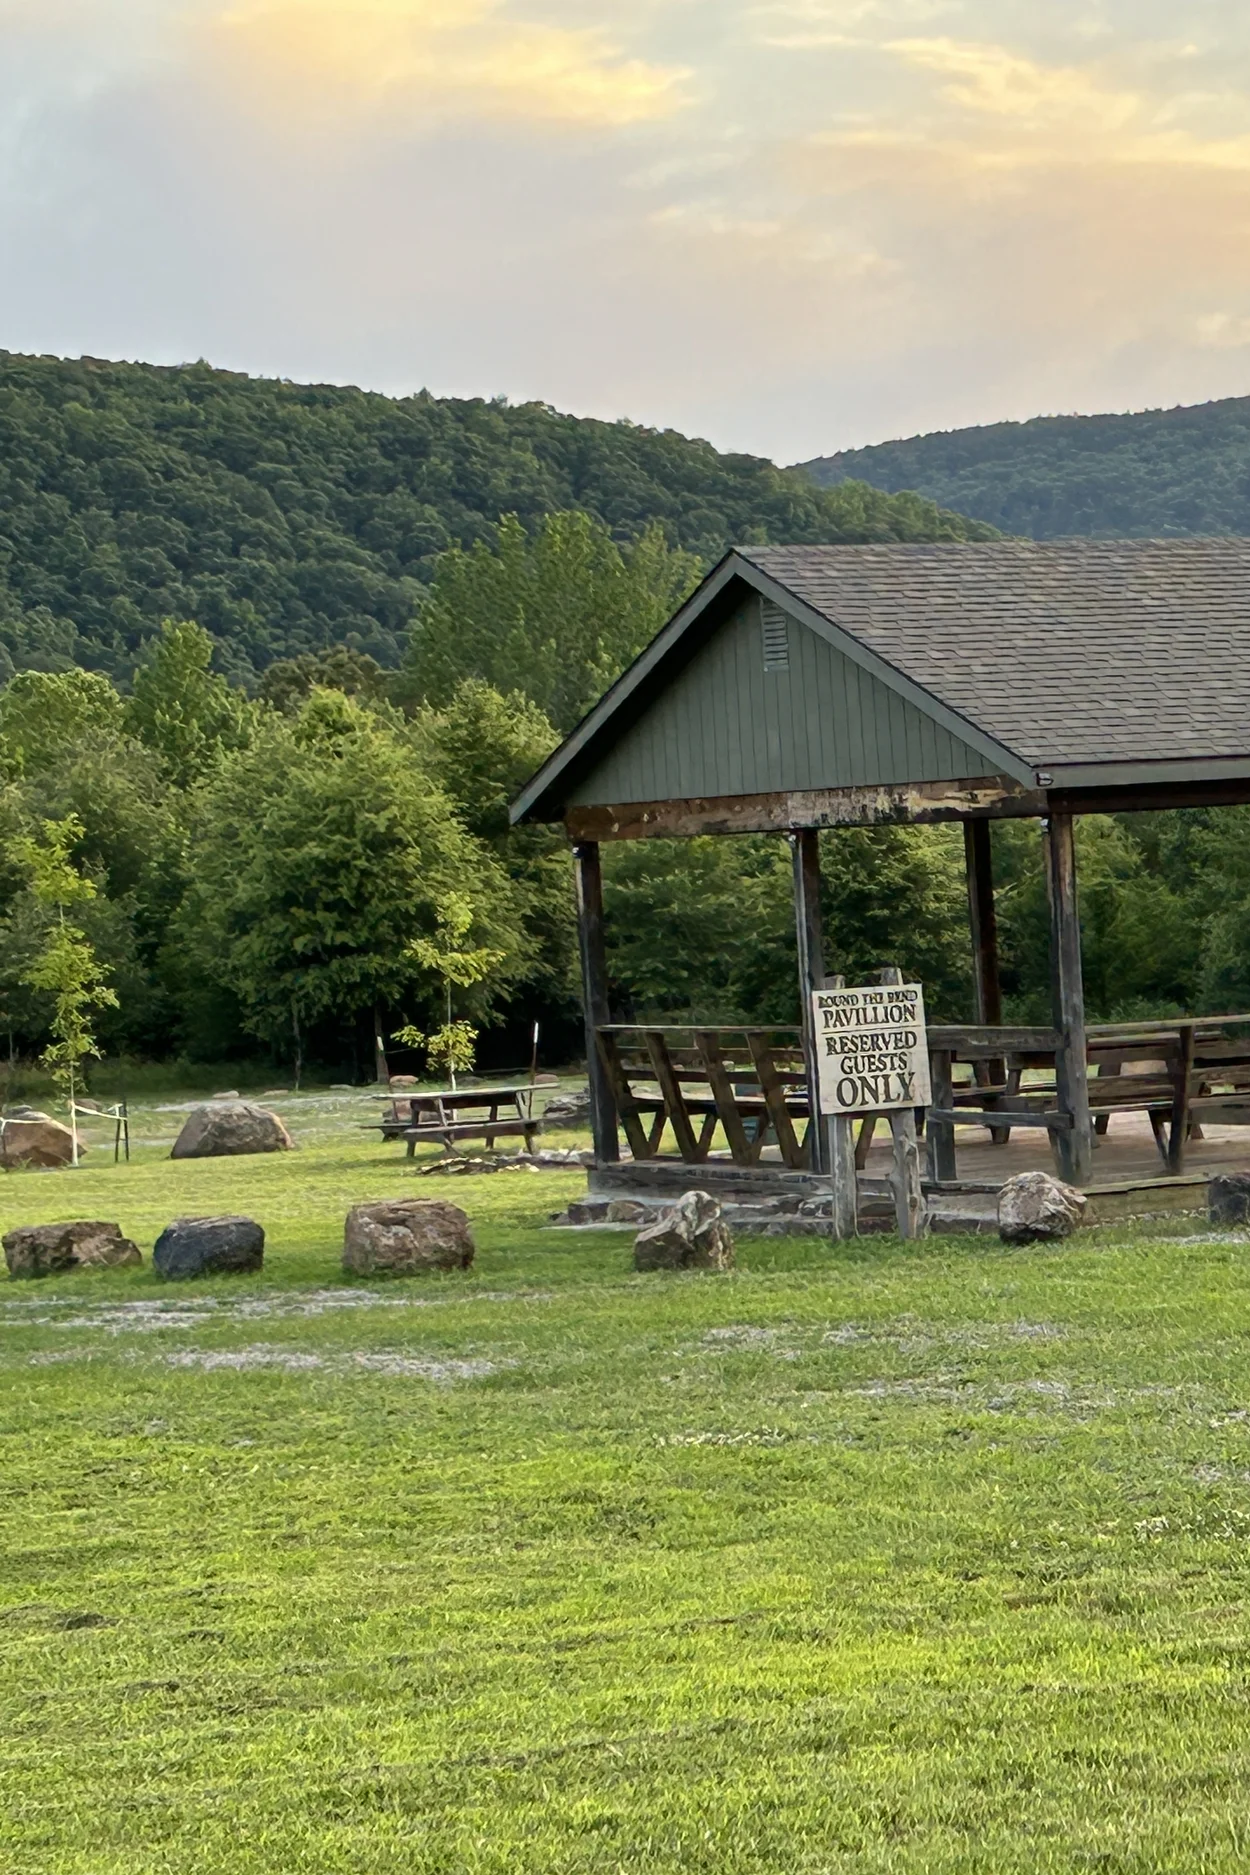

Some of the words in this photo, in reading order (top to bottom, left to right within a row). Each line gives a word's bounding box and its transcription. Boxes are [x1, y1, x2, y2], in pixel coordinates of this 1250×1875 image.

[823, 1004, 917, 1029] PAVILLION
[825, 1030, 918, 1057] RESERVED
[840, 1051, 908, 1075] GUESTS
[836, 1072, 916, 1108] ONLY
